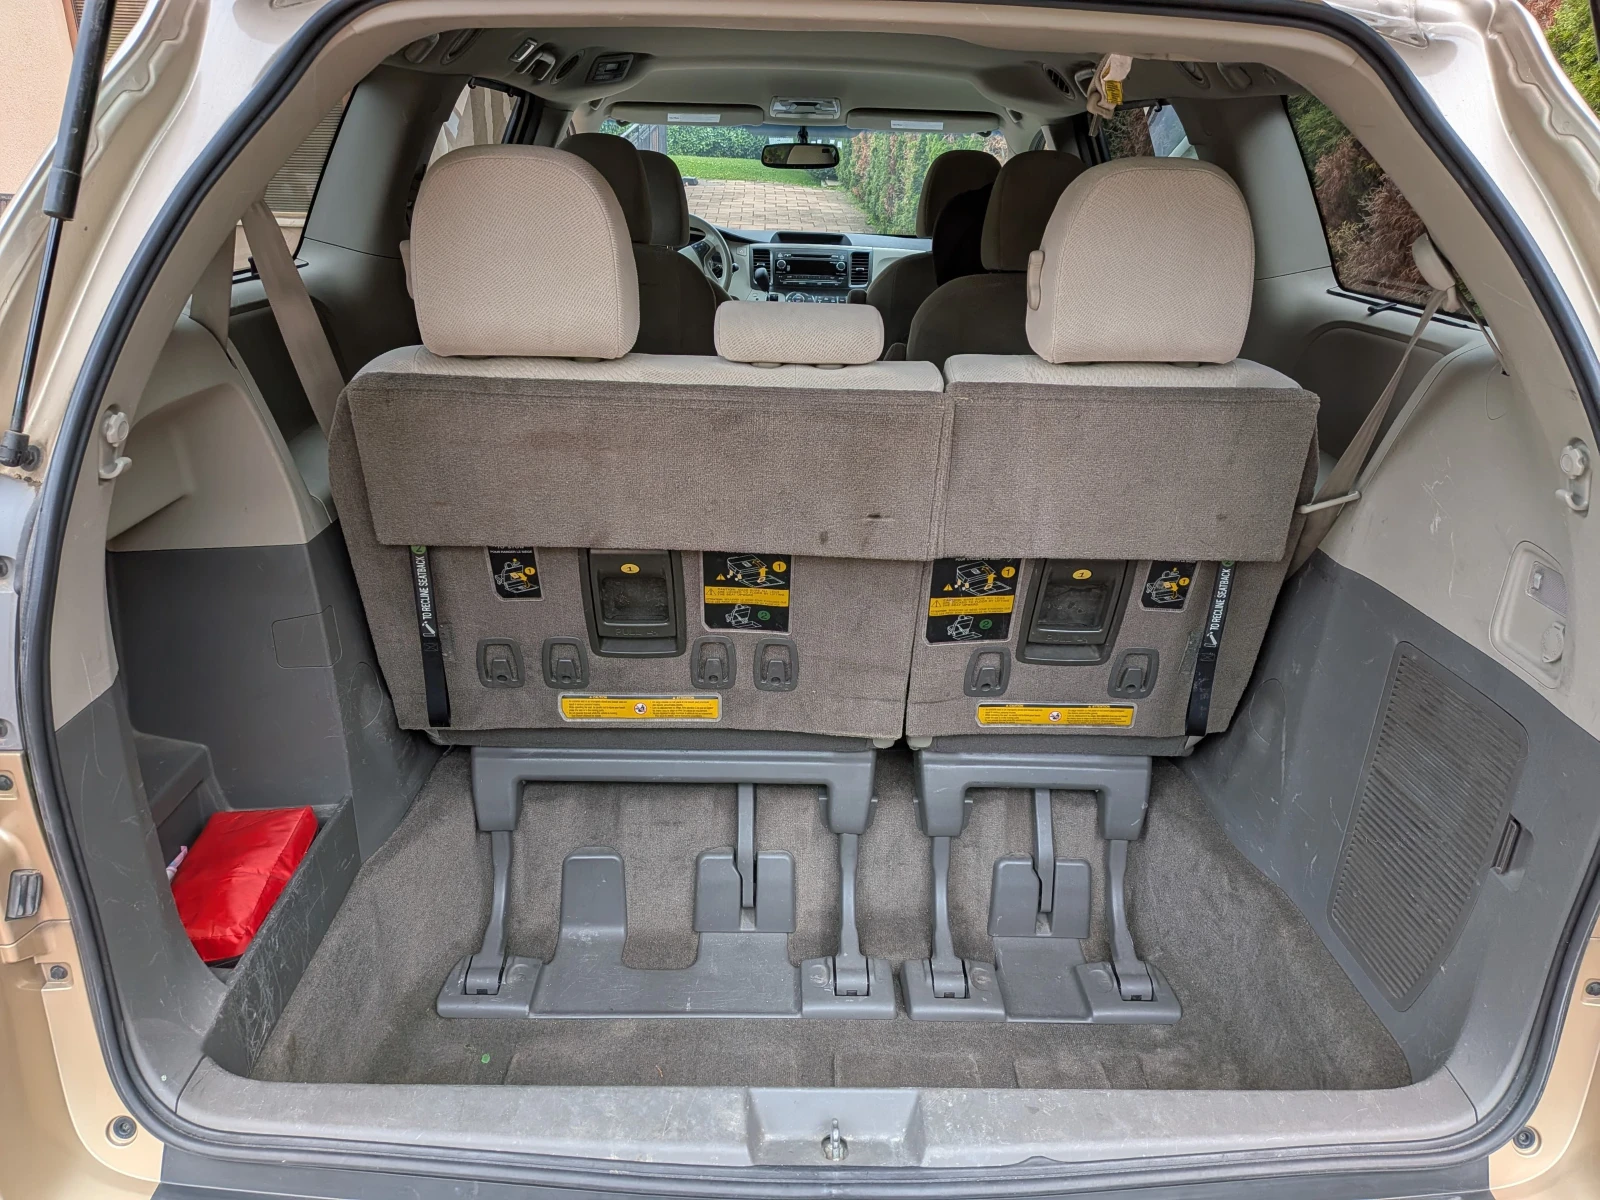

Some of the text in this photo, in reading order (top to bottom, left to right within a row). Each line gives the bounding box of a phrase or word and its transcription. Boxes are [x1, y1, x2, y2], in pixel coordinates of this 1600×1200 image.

[415, 556, 428, 587] SEATBACK
[1217, 568, 1231, 598] SEATBACK
[419, 587, 432, 612] RECLINE
[1211, 598, 1225, 622] RECLINE
